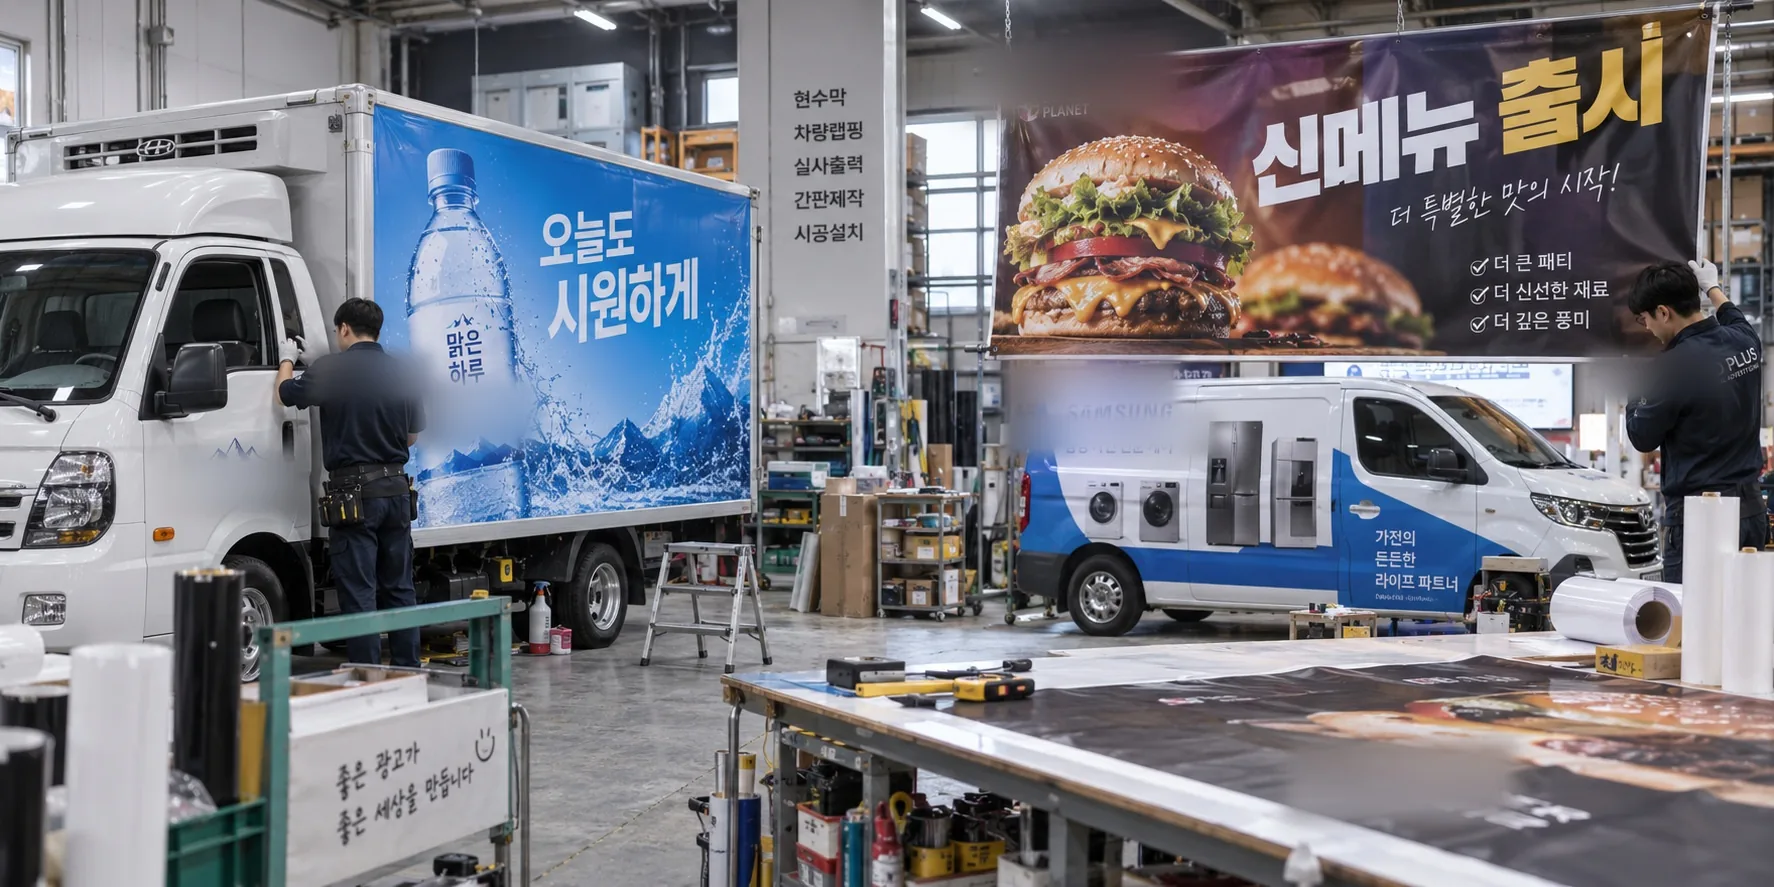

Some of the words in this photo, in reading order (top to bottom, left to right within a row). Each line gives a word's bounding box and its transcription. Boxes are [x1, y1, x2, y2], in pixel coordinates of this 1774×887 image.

[794, 88, 847, 109] 현수막
[1042, 103, 1089, 118] PLANET
[1252, 90, 1480, 207] 신메뉴
[1498, 21, 1664, 155] 출시
[794, 121, 863, 142] 차량랩핑
[794, 155, 863, 176] 실사출력
[794, 189, 864, 210] 간판제작
[1390, 205, 1411, 228] 더
[1420, 186, 1492, 231] 특별한
[1501, 177, 1549, 216] 맛의
[1560, 162, 1621, 202] 시작!
[539, 210, 635, 267] 오늘도
[794, 222, 863, 243] 시공설치
[1494, 254, 1509, 273] 더
[1515, 254, 1533, 272] 큰
[1538, 251, 1572, 271] 패티
[547, 257, 699, 344] 시원하게
[1494, 283, 1509, 301] 더
[1516, 281, 1569, 301] 신선한
[1573, 280, 1610, 299] 재료
[1494, 312, 1509, 331] 더
[1516, 311, 1550, 331] 깊은
[1555, 310, 1590, 330] 풍미
[446, 330, 482, 358] 맑은
[1725, 347, 1758, 372] PLUS
[448, 358, 485, 386] 하루
[1375, 529, 1416, 547] 가전의
[1375, 551, 1416, 569] 든든한
[1375, 572, 1415, 590] 라이프
[1418, 575, 1458, 593] 파트너
[336, 760, 367, 801] 좋은
[375, 741, 420, 780] 광고가
[337, 806, 367, 846] 좋은
[375, 783, 418, 821] 세상을
[425, 762, 475, 802] 만듭니다
